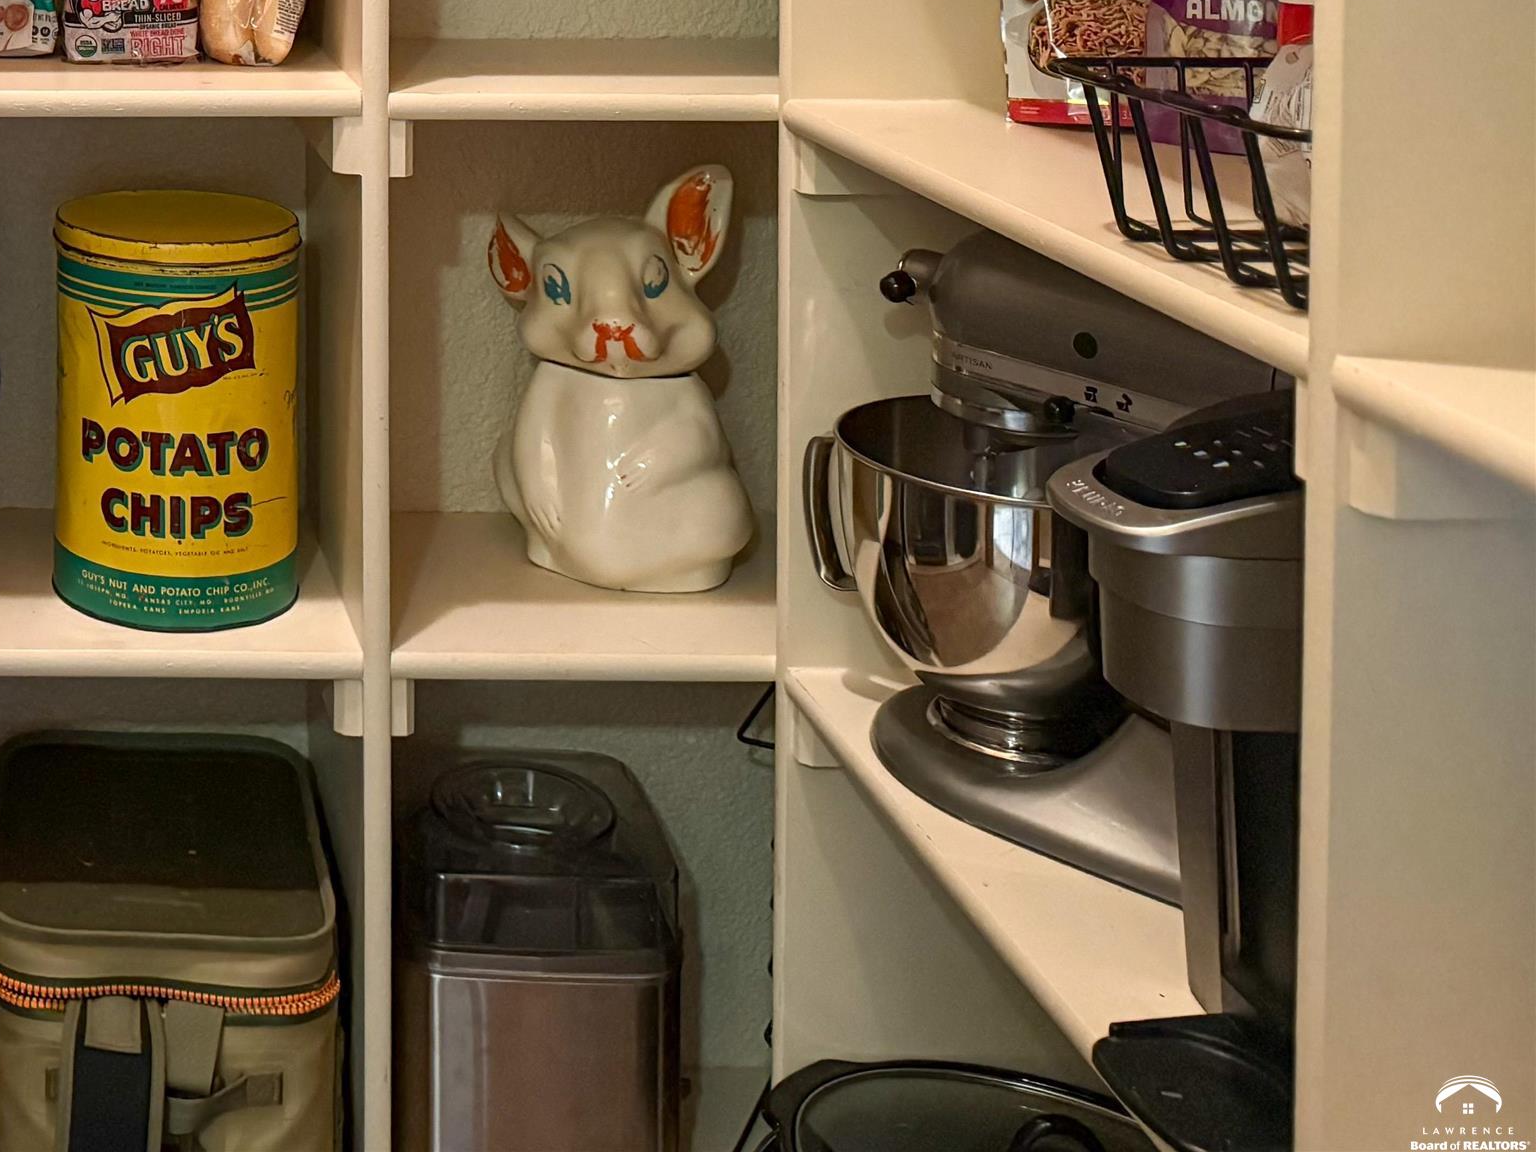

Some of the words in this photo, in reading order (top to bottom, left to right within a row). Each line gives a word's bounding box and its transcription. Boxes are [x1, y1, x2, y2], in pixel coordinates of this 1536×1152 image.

[102, 0, 149, 11] BREAD
[134, 12, 181, 23] THIN-SLICED
[131, 36, 185, 58] RIGHT
[121, 313, 244, 383] GUY'S
[81, 416, 269, 477] POTATO
[101, 488, 255, 540] CHIPS
[82, 570, 105, 585] GUY'S
[109, 578, 127, 591] NUT
[132, 583, 156, 595] AND
[161, 586, 201, 597] POTATO
[206, 585, 230, 596] CHIP
